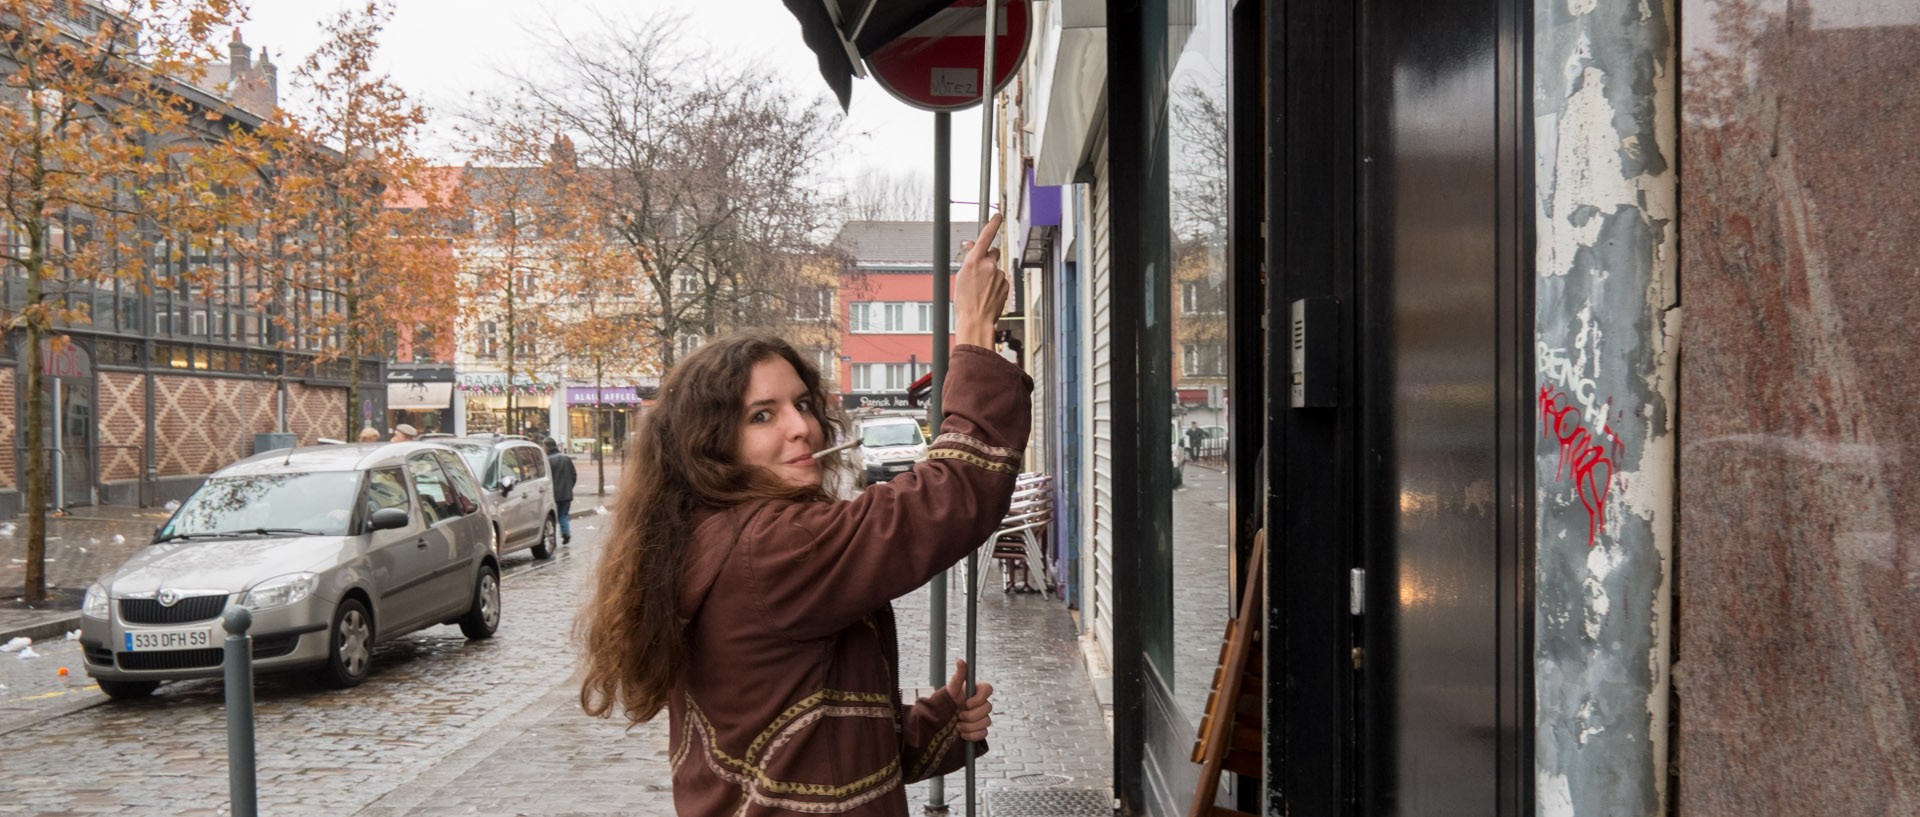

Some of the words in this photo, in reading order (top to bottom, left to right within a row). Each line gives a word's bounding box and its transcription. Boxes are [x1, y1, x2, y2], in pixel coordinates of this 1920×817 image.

[135, 634, 158, 648] 533
[161, 633, 187, 647] DFH
[190, 631, 207, 646] 59
